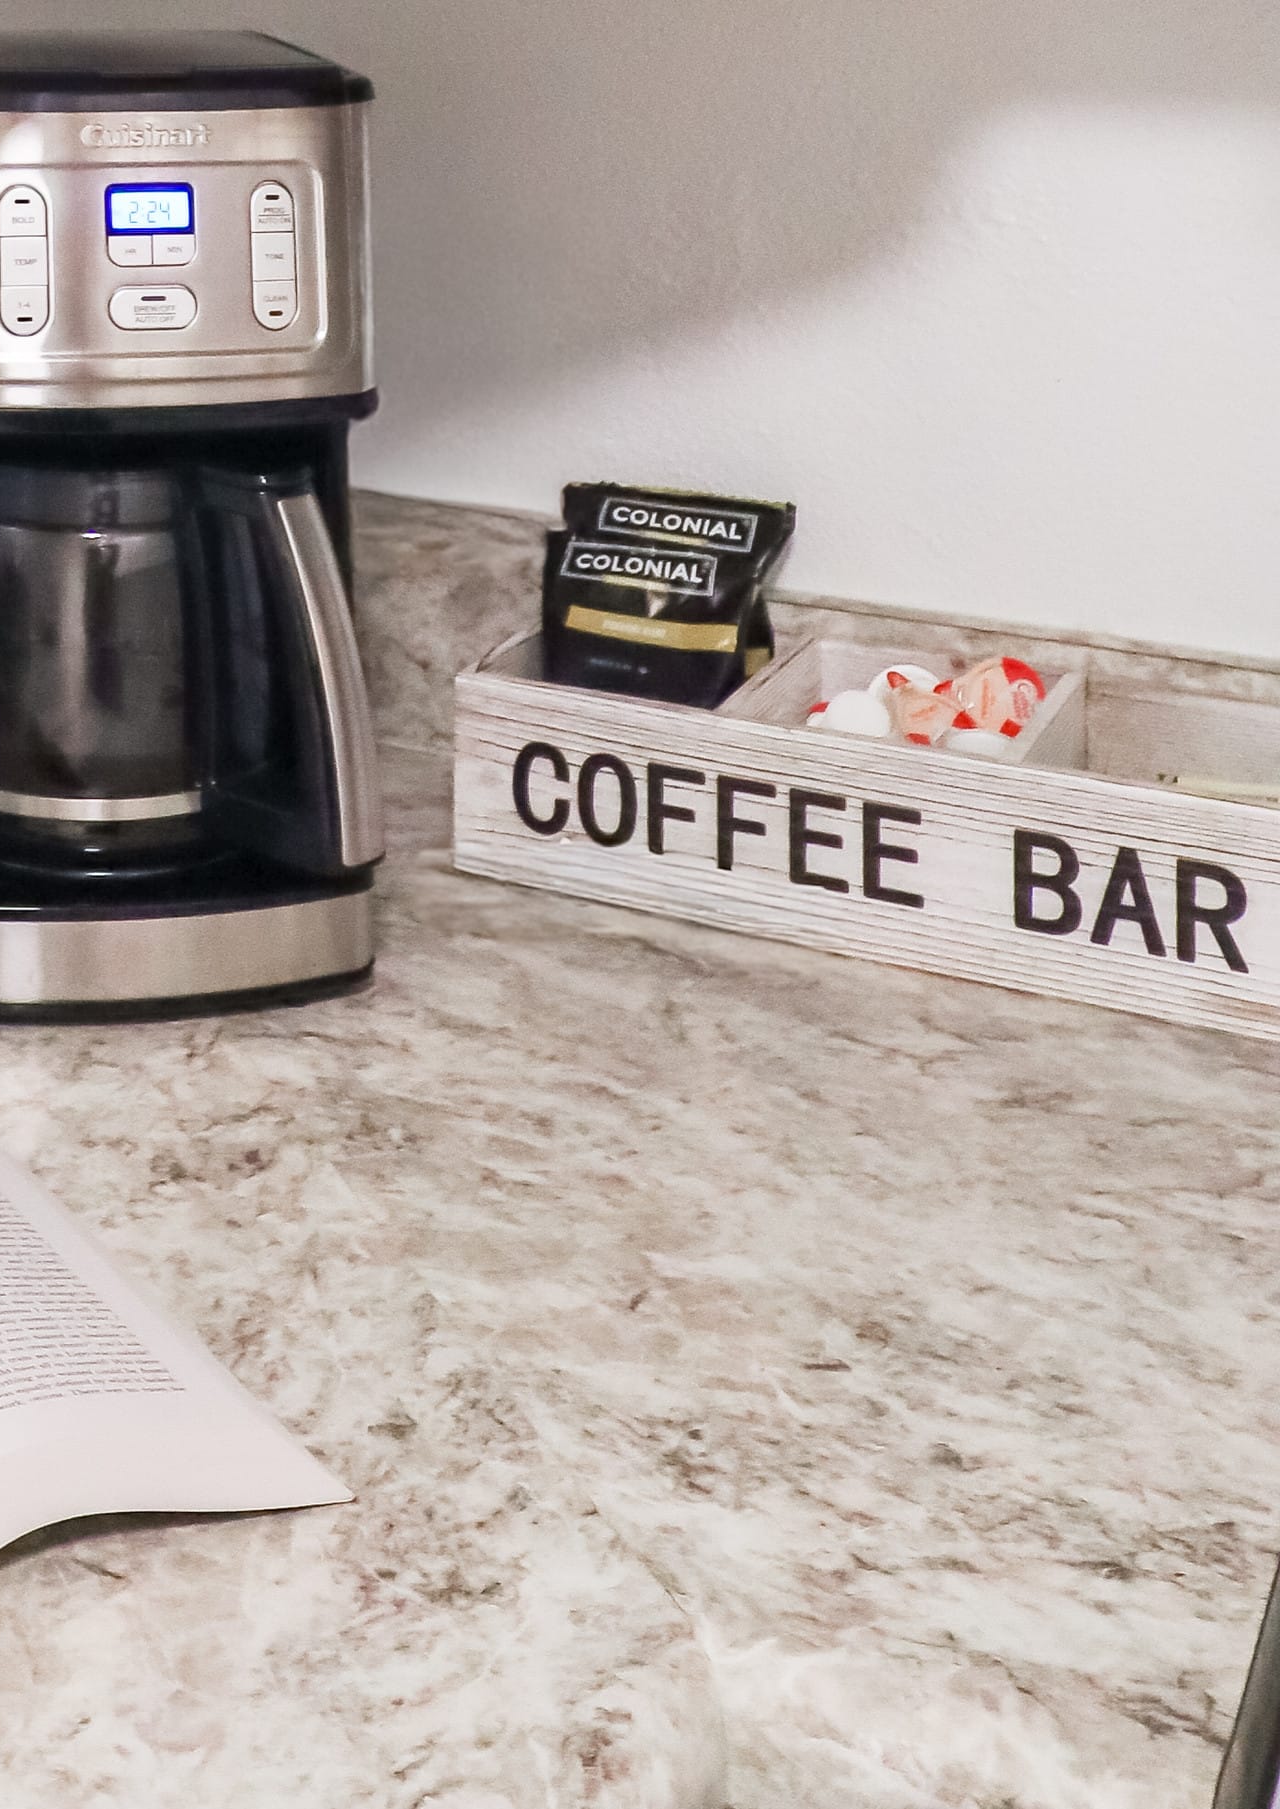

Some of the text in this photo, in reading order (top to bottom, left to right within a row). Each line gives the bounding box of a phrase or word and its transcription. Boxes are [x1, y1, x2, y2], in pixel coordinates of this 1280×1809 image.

[80, 122, 211, 148] Cuisinart
[612, 506, 742, 540] COLONIAL
[575, 553, 703, 584] COLONIAL
[512, 741, 1250, 974] COFFEE BAR
